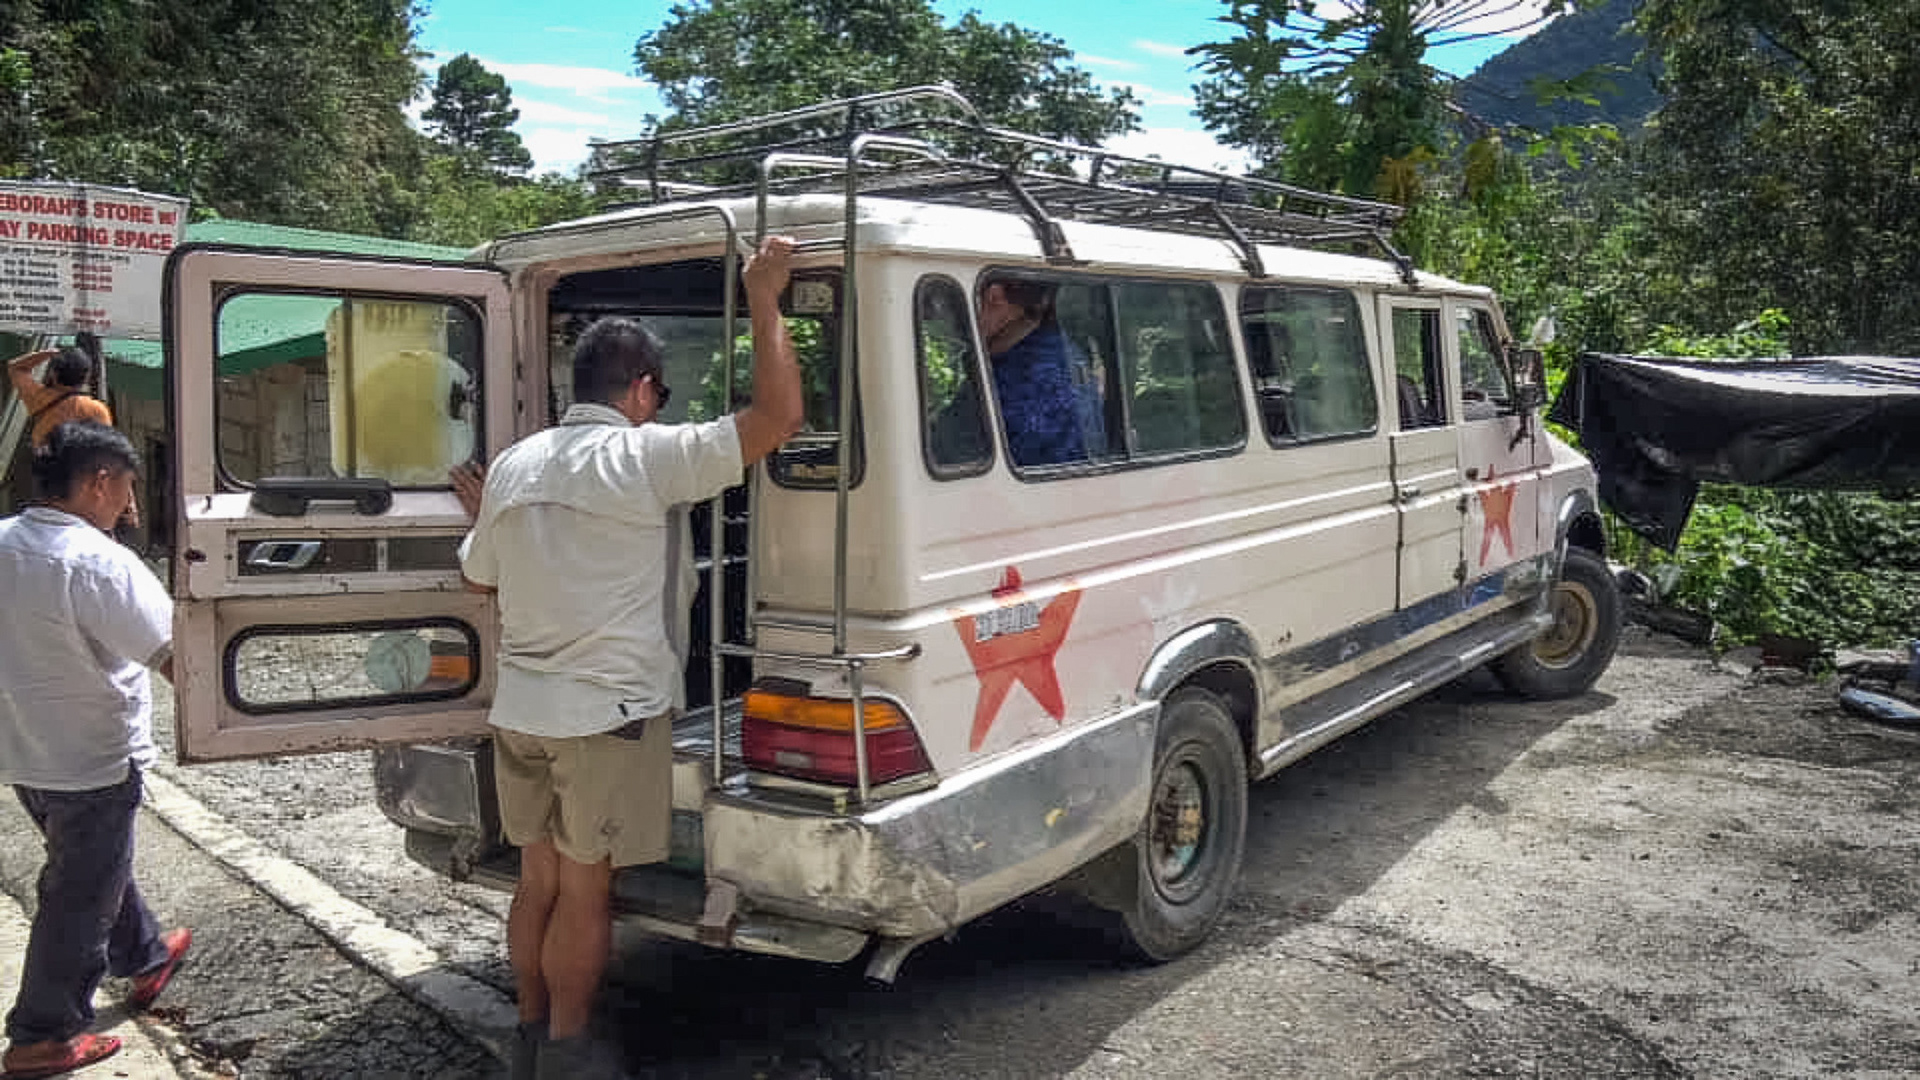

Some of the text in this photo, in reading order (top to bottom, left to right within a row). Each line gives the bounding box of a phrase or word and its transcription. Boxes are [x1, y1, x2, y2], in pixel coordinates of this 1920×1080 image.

[94, 201, 154, 224] STORE
[28, 222, 109, 245] PARKING
[114, 230, 173, 251] SPACE
